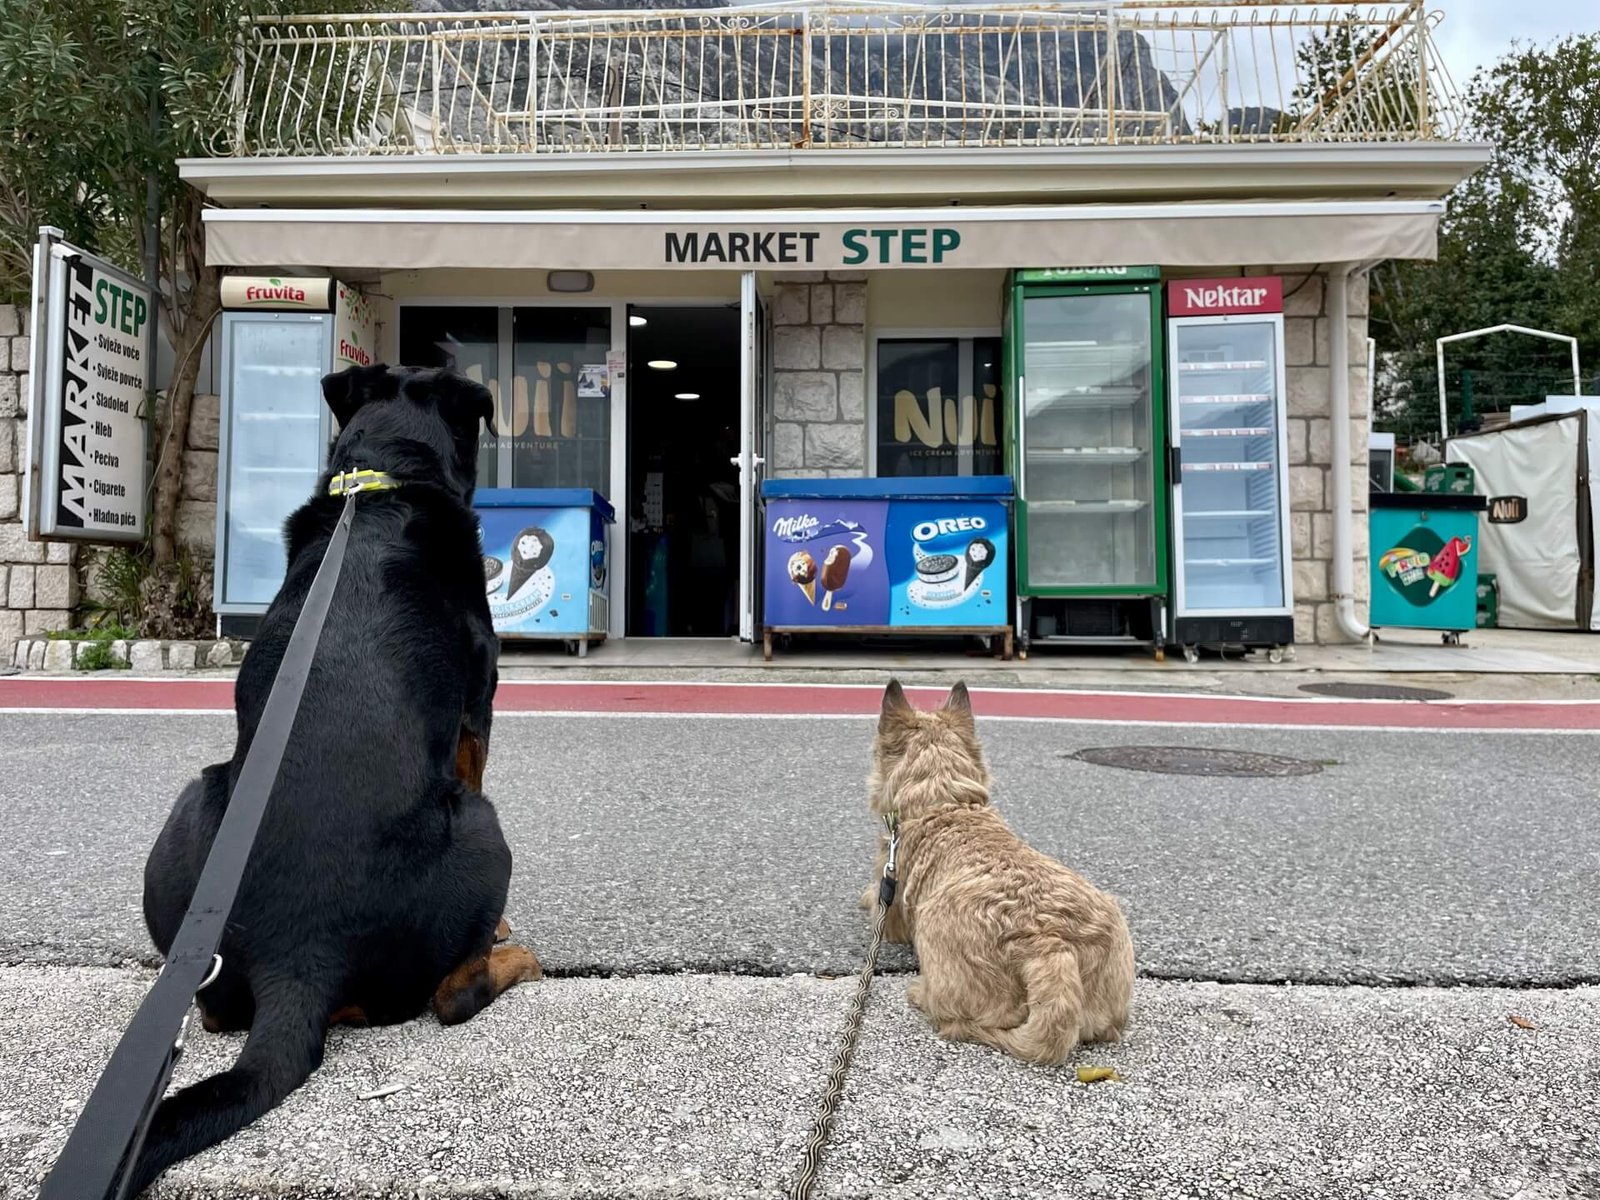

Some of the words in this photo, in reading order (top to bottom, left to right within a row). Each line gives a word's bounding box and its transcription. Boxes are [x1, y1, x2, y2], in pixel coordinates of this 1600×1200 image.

[664, 232, 820, 264] MARKET
[842, 228, 961, 265] STEP
[246, 286, 305, 302] Fruvita
[1183, 284, 1268, 308] Nektar
[95, 278, 147, 338] STEP
[98, 333, 122, 355] Svježe
[340, 339, 370, 366] Fruvita
[96, 362, 119, 384] Svježe
[60, 257, 94, 524] MARKET
[95, 391, 129, 414] Sladoled
[95, 420, 113, 438] Hleb
[500, 441, 559, 450] ADVENTURE
[924, 449, 953, 457] CREAM
[94, 449, 119, 468] Peciva
[93, 479, 126, 498] Cigarete
[93, 508, 120, 525] Hladna
[772, 513, 820, 537] Milka
[912, 516, 986, 542] OREO
